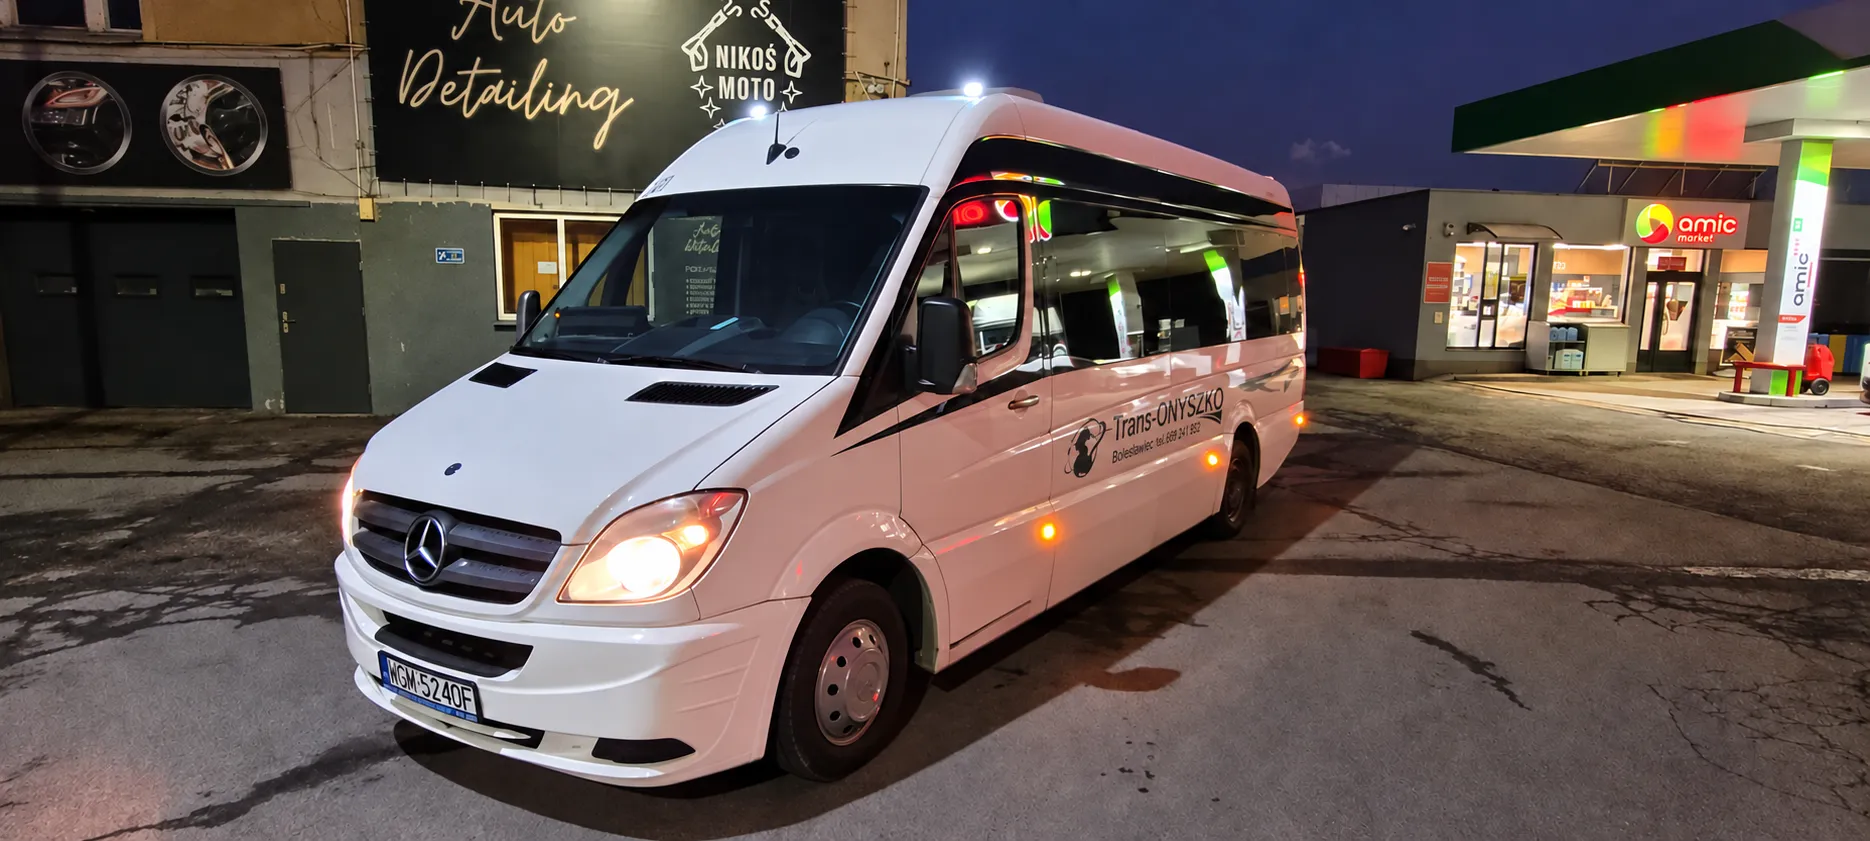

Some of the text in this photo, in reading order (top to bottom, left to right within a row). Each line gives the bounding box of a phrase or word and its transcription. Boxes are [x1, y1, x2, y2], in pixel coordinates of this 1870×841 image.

[715, 43, 777, 71] NIKOŚ
[399, 48, 634, 150] Detailing
[718, 75, 775, 101] MOTO
[1677, 234, 1713, 242] market
[1678, 214, 1737, 233] amic
[1793, 253, 1809, 306] amic
[1113, 387, 1224, 441] Trans-ONYSZKO
[388, 660, 417, 693] WGM
[419, 674, 472, 710] 5240F
